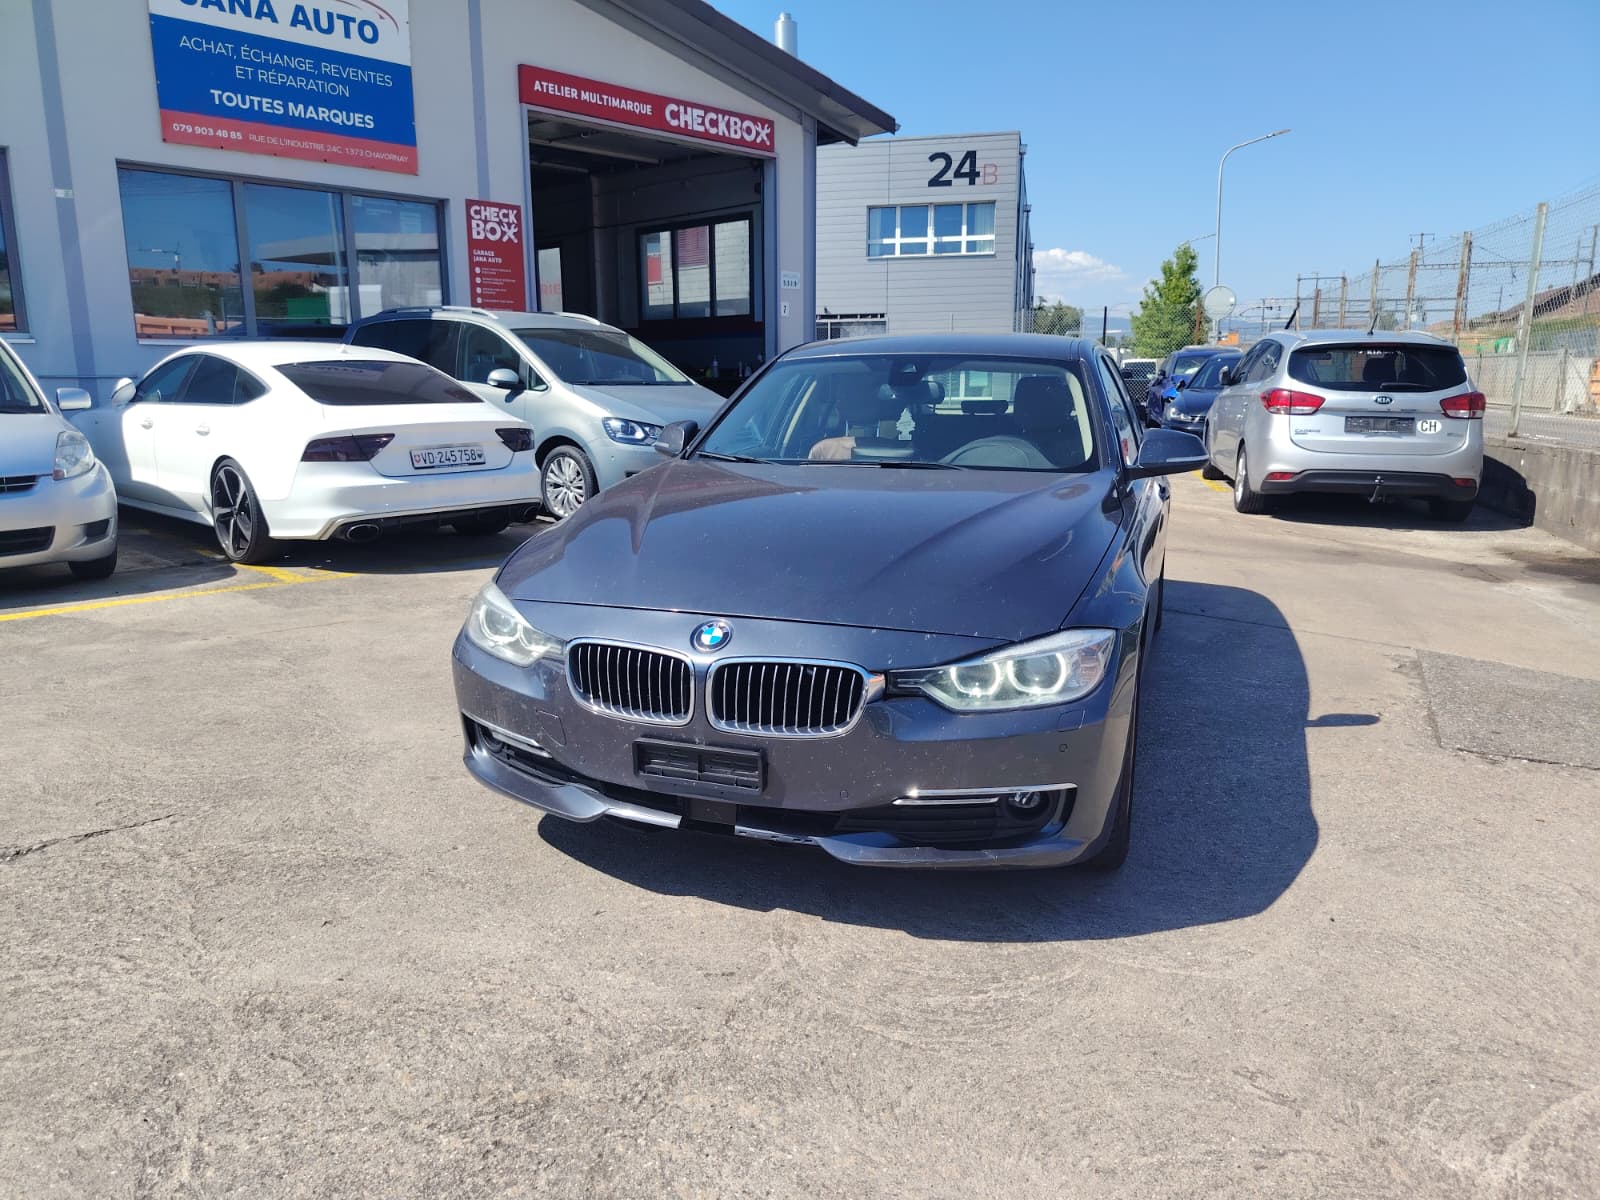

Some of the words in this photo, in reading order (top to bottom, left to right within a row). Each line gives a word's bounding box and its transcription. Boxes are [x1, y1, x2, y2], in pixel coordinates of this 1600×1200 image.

[180, 0, 279, 24] ANA
[289, 3, 379, 45] AUTO
[179, 35, 237, 60] ACHAT,
[240, 43, 319, 75] ÉCHANGE,
[321, 62, 393, 87] REVENTES
[235, 65, 254, 80] ET
[258, 68, 350, 97] RÉPARATION
[209, 88, 285, 115] TOUTES
[288, 101, 375, 129] MARQUES
[533, 80, 578, 99] ATELIER
[580, 89, 653, 116] MULTIMARQUE
[664, 103, 771, 146] CHECKBOX
[172, 123, 193, 134] 079
[194, 126, 214, 136] 903
[470, 205, 518, 224] CHECK
[471, 220, 519, 244] BOX
[1420, 420, 1437, 432] CH
